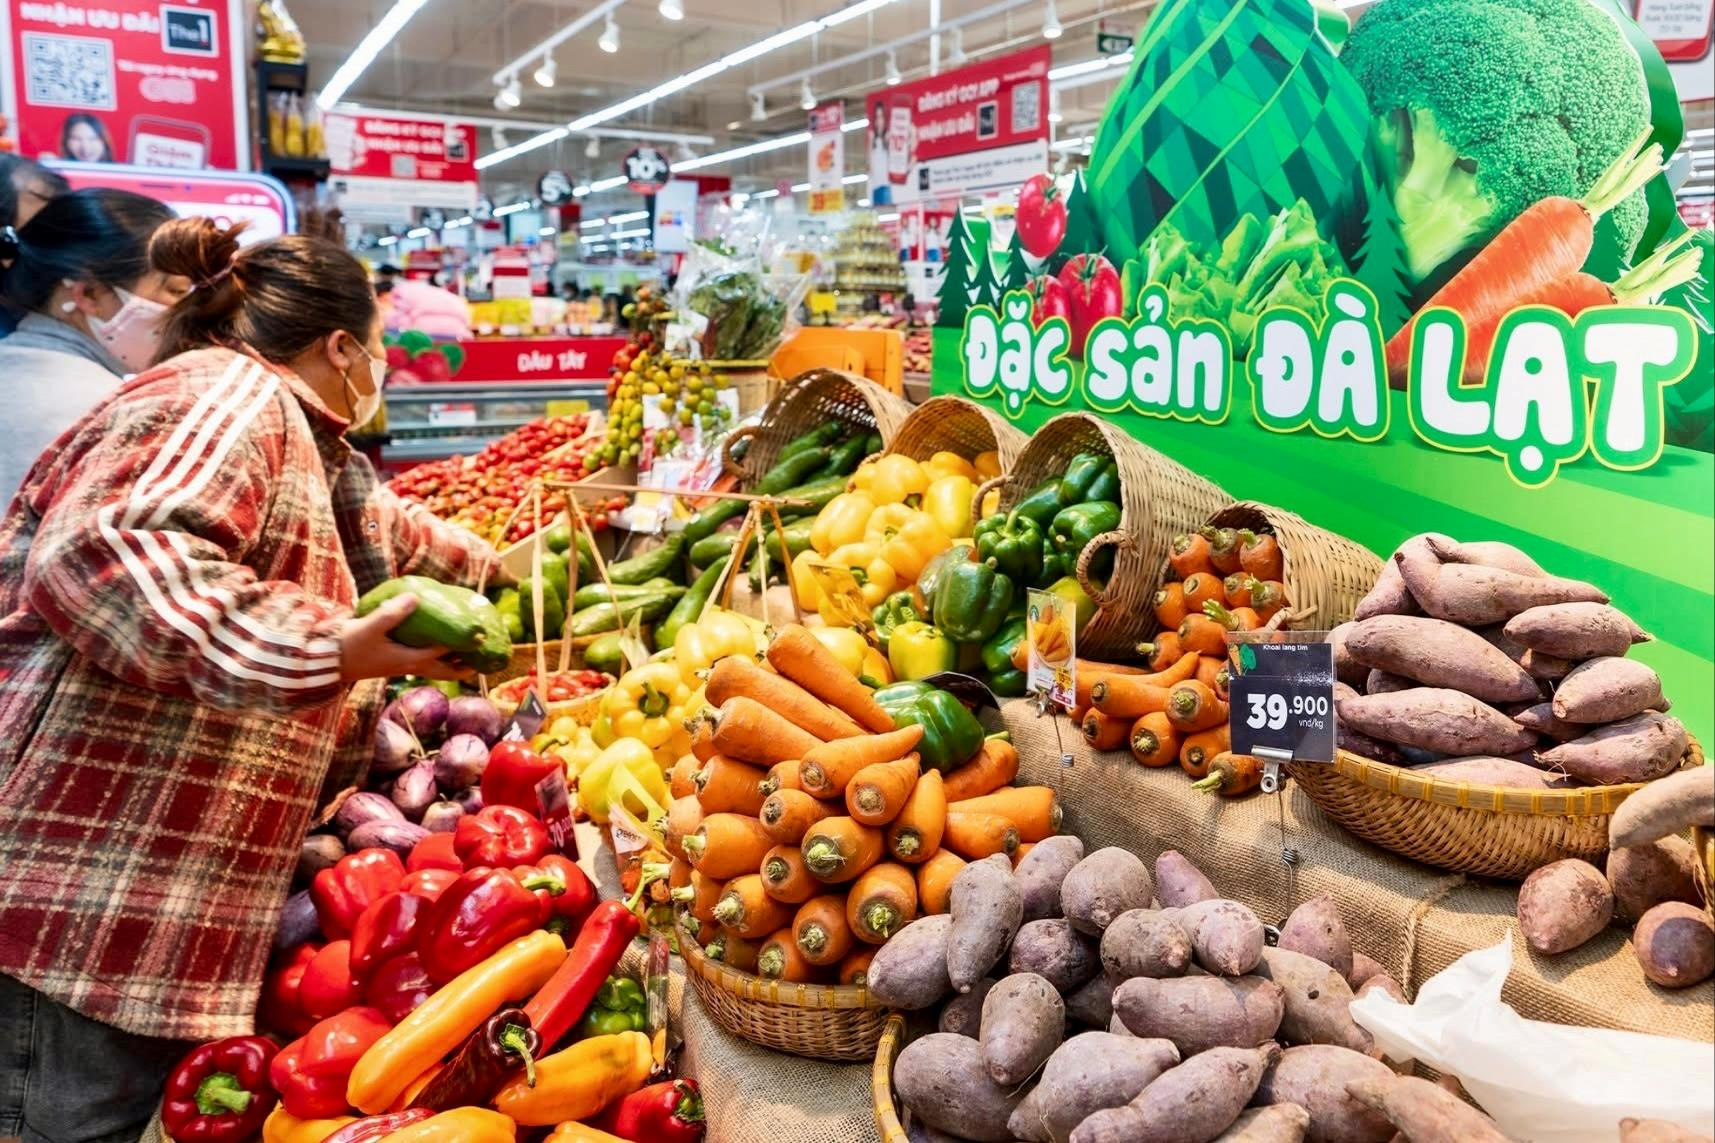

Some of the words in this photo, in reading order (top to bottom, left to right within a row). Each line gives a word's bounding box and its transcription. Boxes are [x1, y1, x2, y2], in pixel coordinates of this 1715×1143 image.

[965, 302, 1067, 409] Đặc
[1089, 294, 1223, 415] sản
[1256, 293, 1377, 427] ĐÀ
[1417, 322, 1679, 472] LẠT
[1282, 644, 1296, 652] lang
